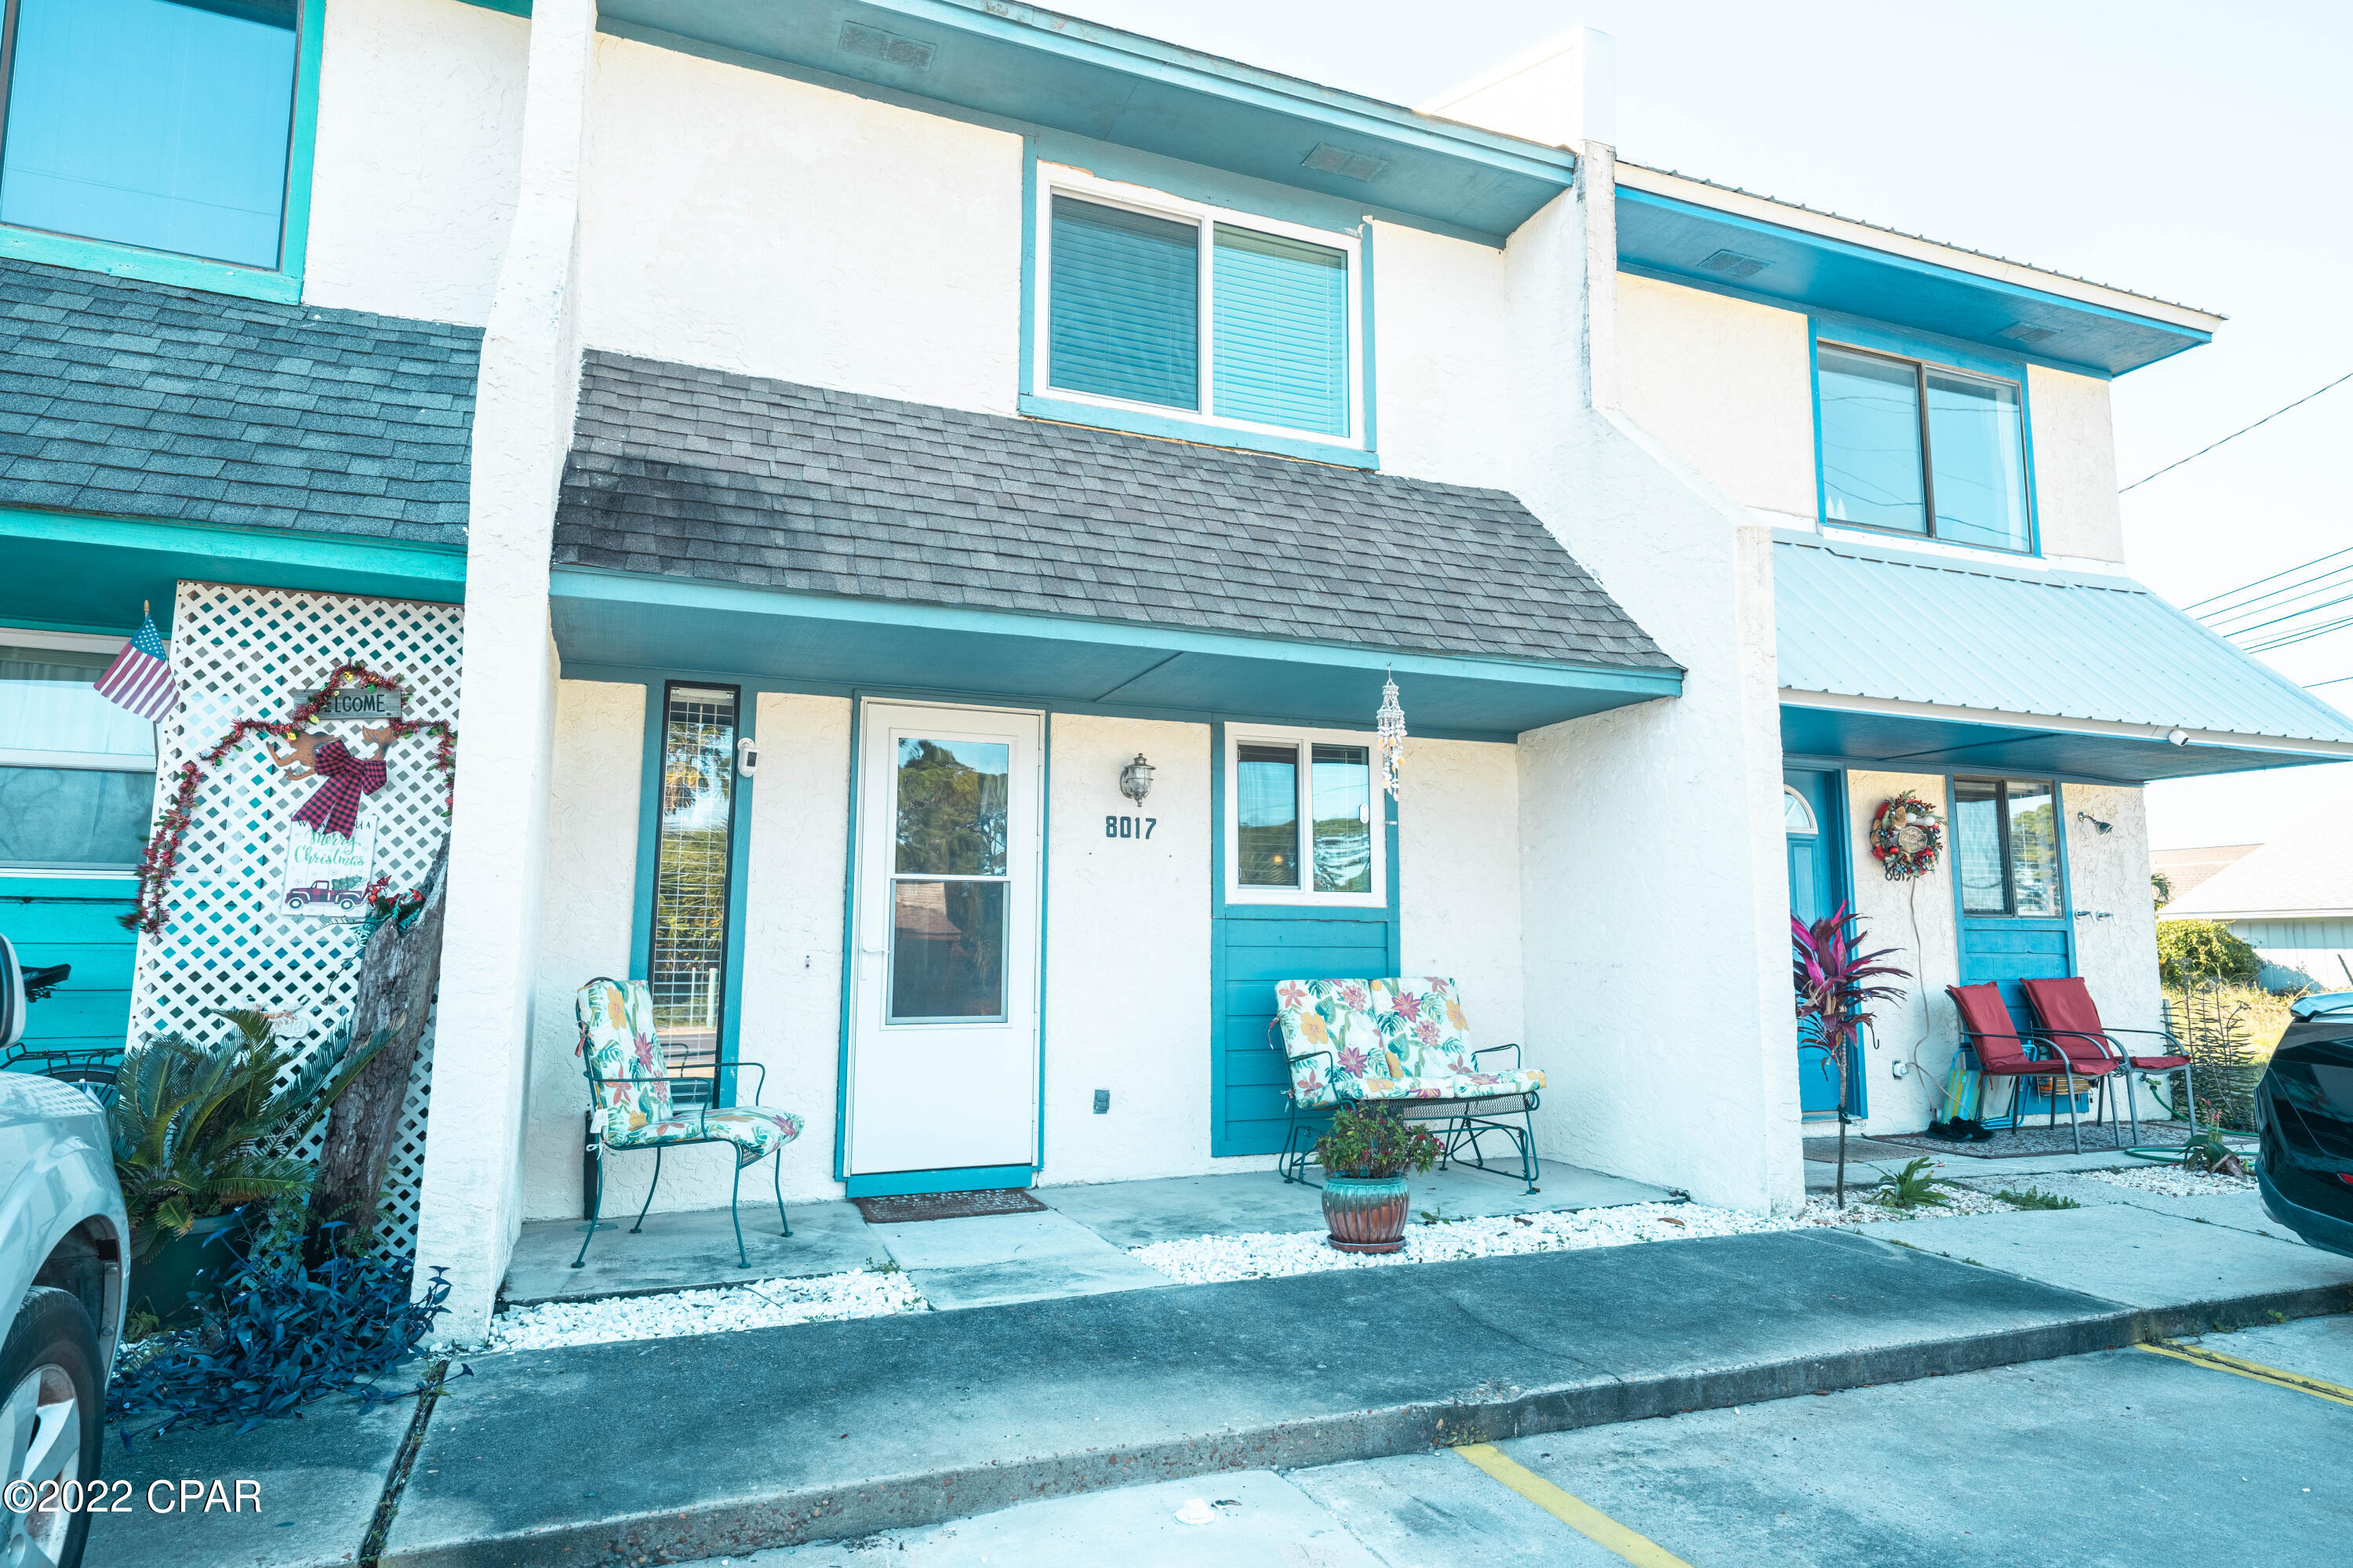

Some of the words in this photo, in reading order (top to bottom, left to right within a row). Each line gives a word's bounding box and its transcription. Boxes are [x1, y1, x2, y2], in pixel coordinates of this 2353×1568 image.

[1106, 816, 1157, 839] 8017
[304, 829, 362, 855] Merry
[294, 845, 365, 867] Christmas
